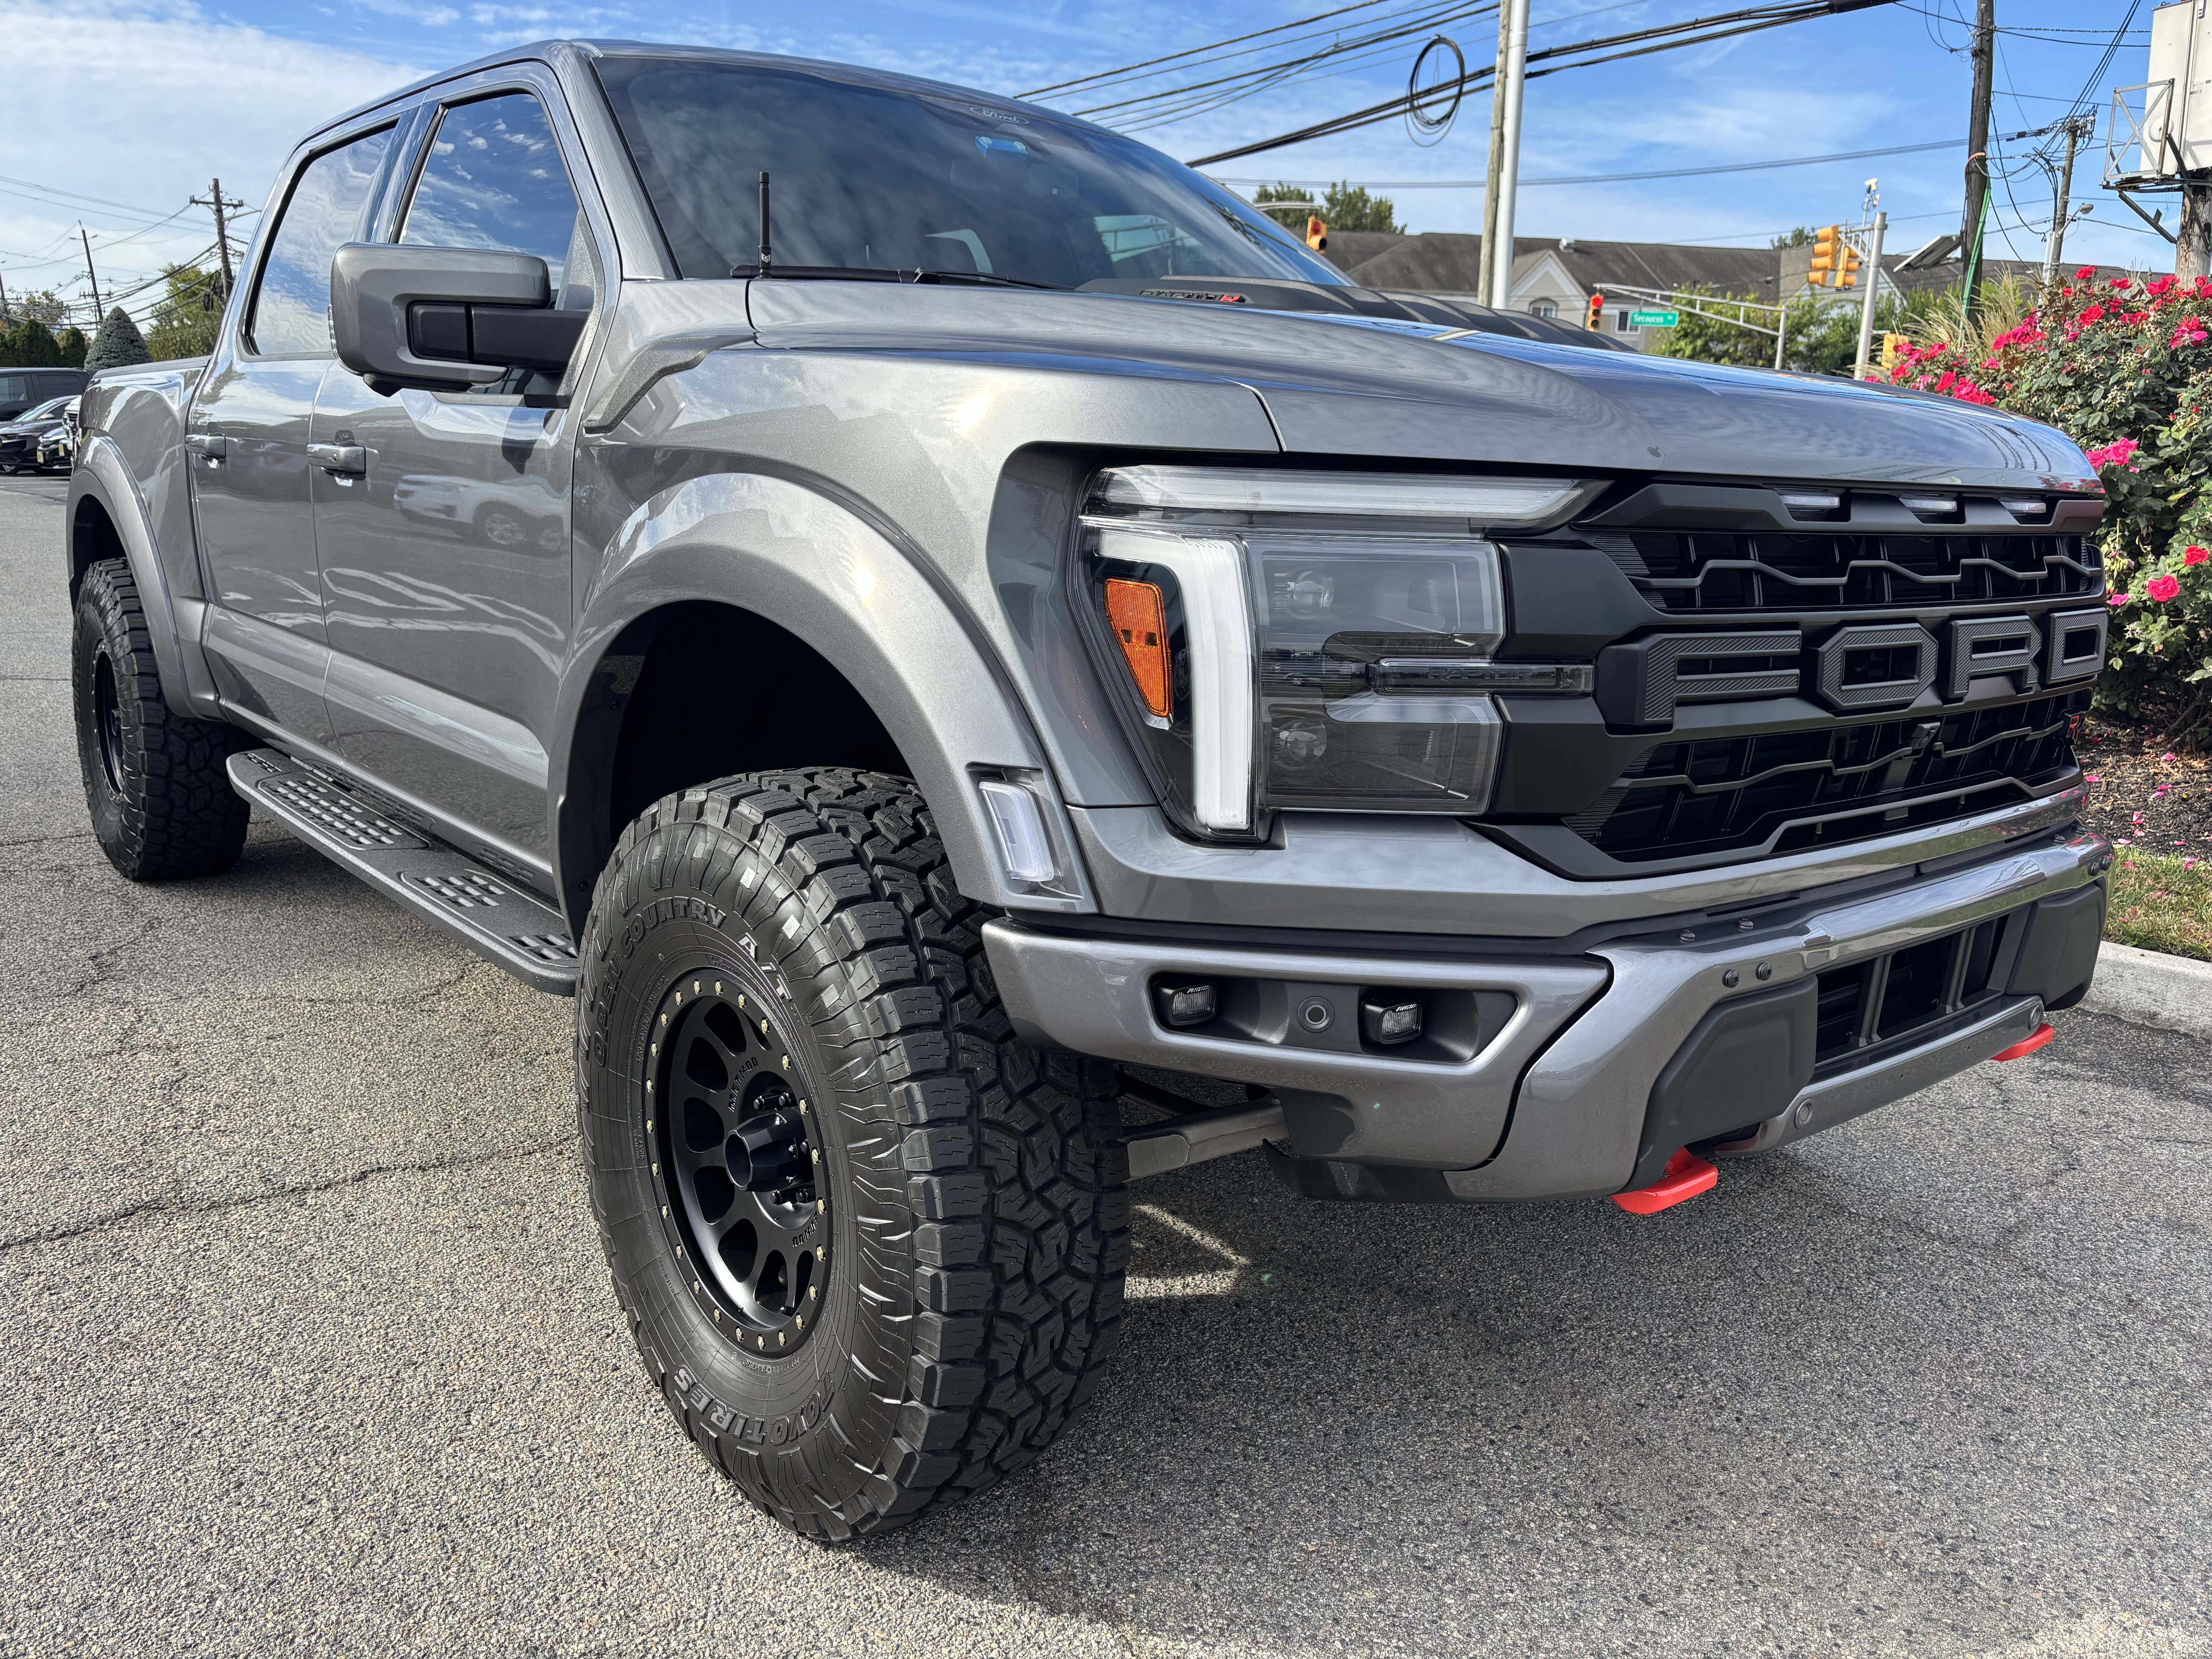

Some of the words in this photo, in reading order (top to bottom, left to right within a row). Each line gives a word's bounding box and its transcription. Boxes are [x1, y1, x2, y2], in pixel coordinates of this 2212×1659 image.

[981, 108, 1020, 123] Ford
[1428, 668, 1535, 683] RAPTOR
[1632, 607, 2108, 725] FORD
[594, 951, 623, 1067] OPEN
[620, 895, 727, 958] COUNTRY
[1187, 985, 1209, 994] RIGID
[1396, 1003, 1418, 1012] RIGID
[728, 1056, 758, 1113] METHOD
[672, 1364, 764, 1444] TIRES
[770, 1369, 835, 1445] TOYO
